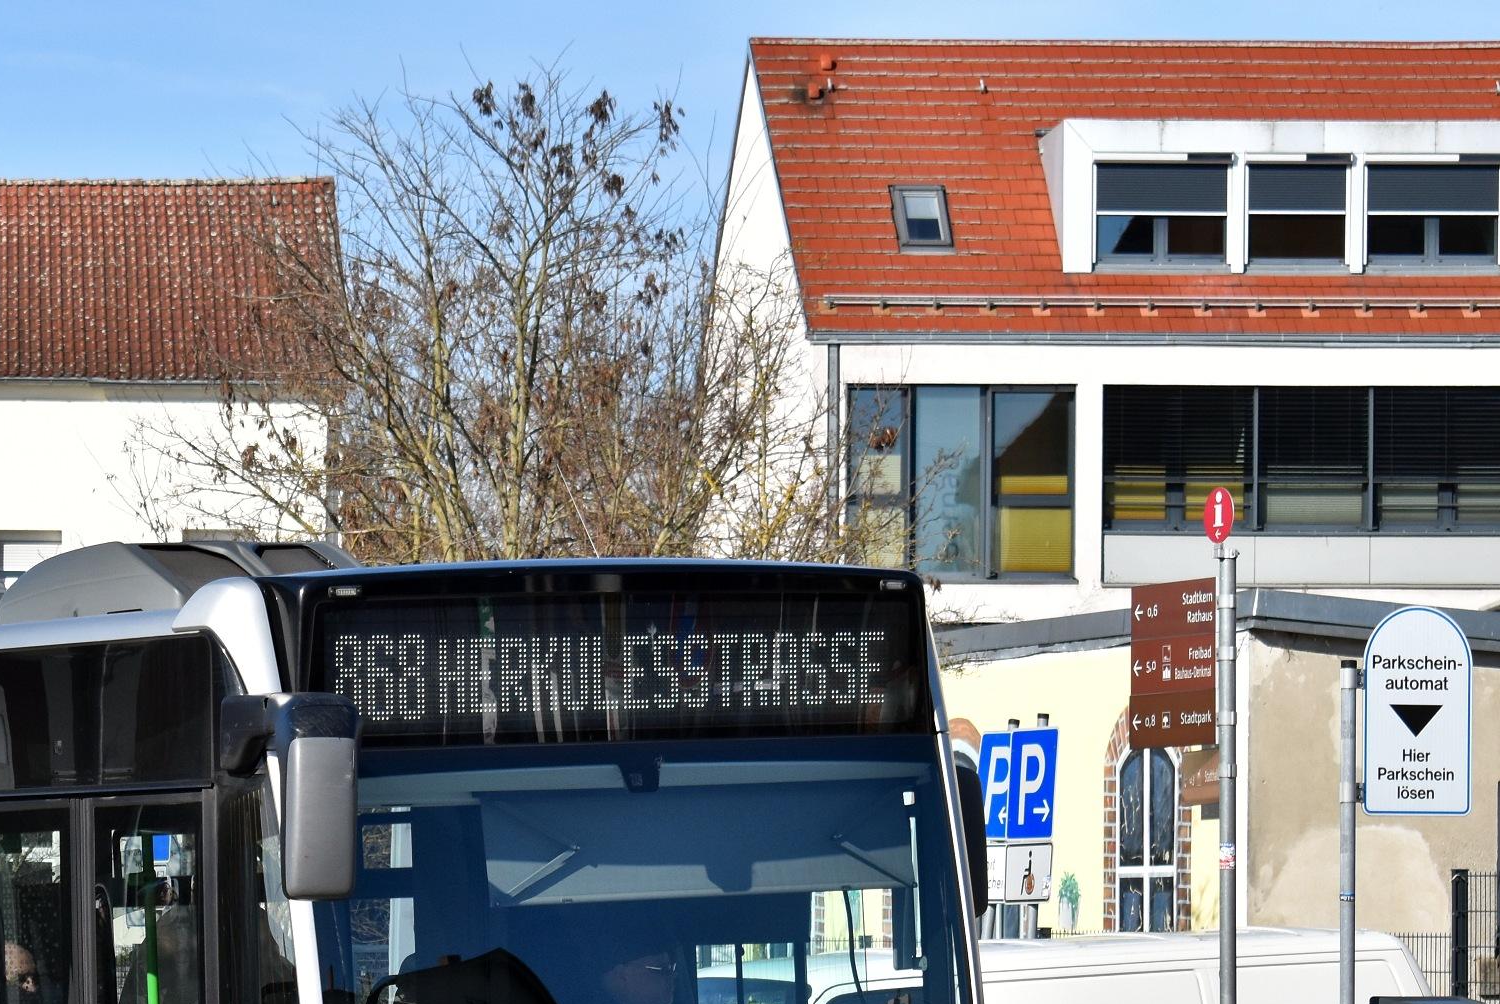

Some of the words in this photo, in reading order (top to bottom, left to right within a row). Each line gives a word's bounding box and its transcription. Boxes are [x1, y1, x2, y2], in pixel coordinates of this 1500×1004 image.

[1182, 592, 1213, 605] Stadtkern
[1147, 604, 1158, 619] 0,6
[1187, 611, 1213, 623] Rathaus
[1188, 645, 1212, 660] Freibad
[1372, 655, 1463, 672] Parkschein-
[334, 634, 426, 721] 868
[441, 630, 886, 716] HERKULESSTRASSE
[1175, 664, 1212, 680] Bauhaus-Denkmal
[1385, 677, 1449, 692] automat
[1180, 710, 1212, 727] Stadtpark
[1402, 749, 1431, 763] Hier
[1377, 767, 1455, 783] Parkschein
[1018, 744, 1046, 826] P
[1396, 785, 1435, 801] lösen
